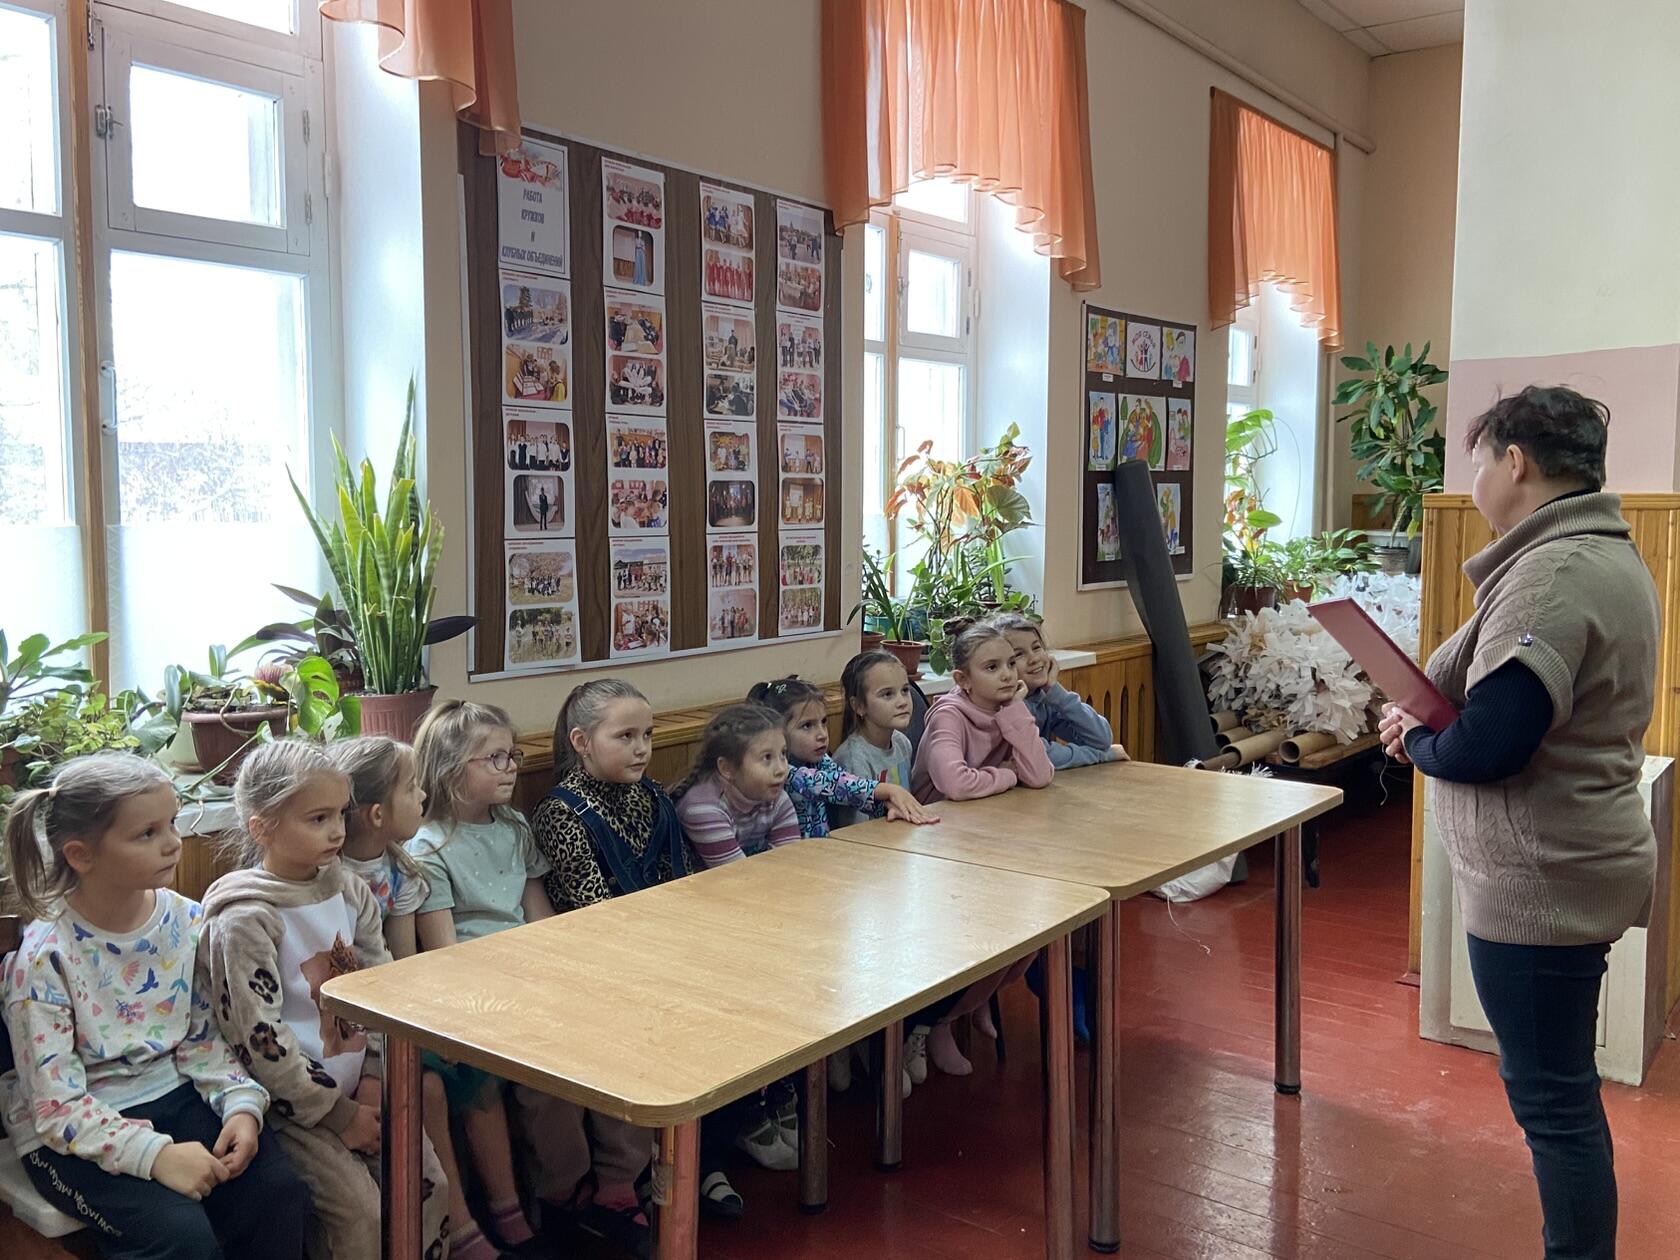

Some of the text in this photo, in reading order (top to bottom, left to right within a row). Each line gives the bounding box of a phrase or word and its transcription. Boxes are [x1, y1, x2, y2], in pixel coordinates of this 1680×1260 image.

[523, 188, 543, 204] РАБОТА
[521, 208, 545, 224] КРУЖКОВ
[531, 231, 536, 242] И
